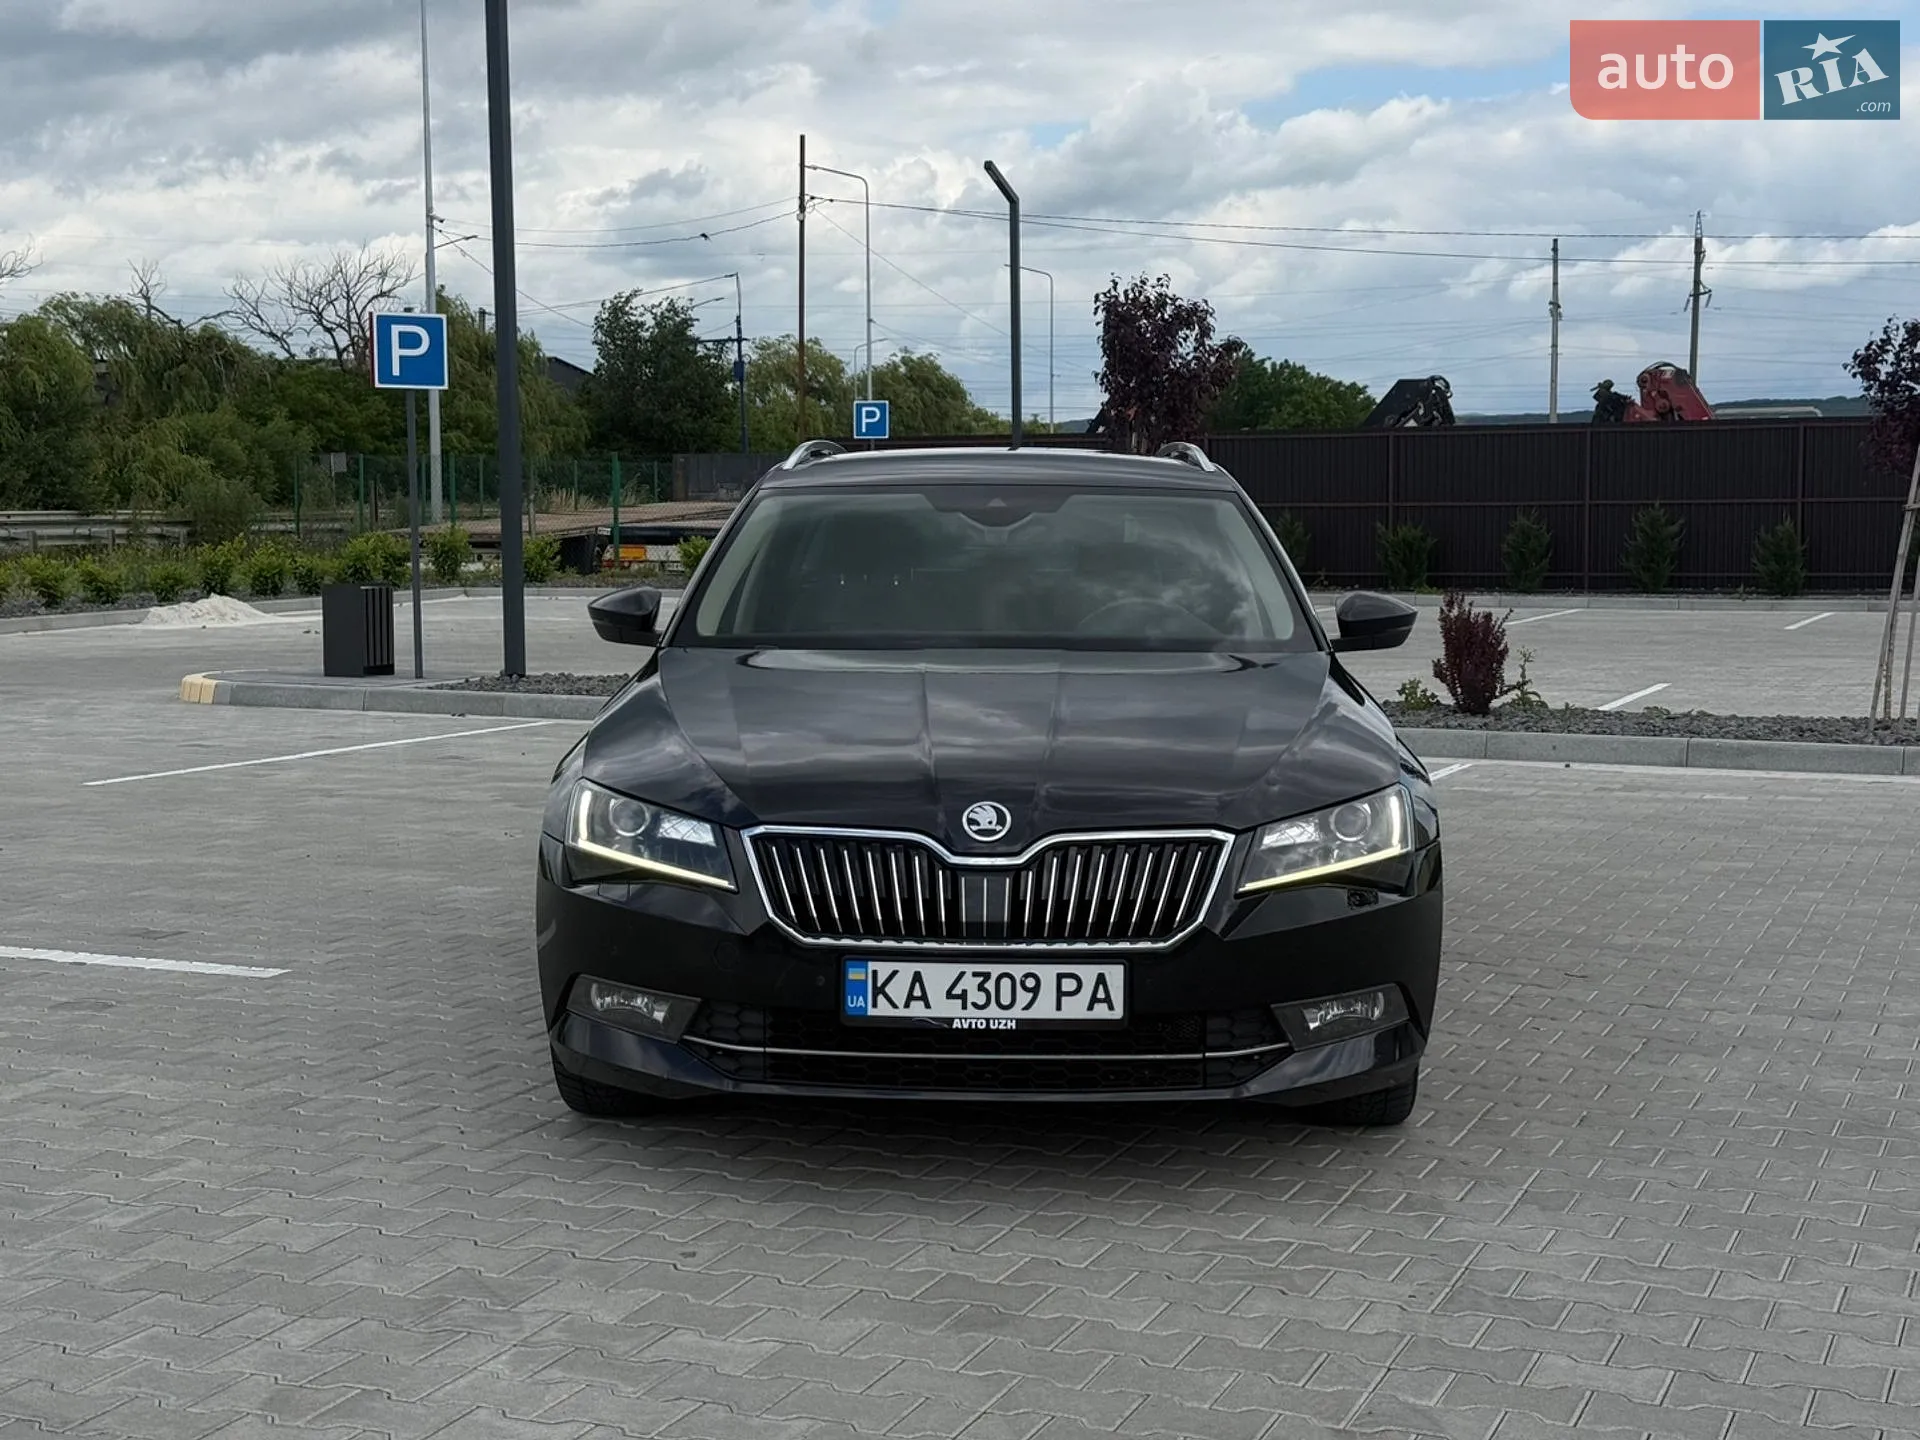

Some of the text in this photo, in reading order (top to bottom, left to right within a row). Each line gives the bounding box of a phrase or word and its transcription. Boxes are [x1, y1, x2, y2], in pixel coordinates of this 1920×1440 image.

[391, 324, 430, 376] P
[862, 406, 880, 433] P
[847, 995, 866, 1008] UA
[871, 969, 1116, 1012] KA 4309 PA
[952, 1018, 1016, 1030] AVTO UZH
